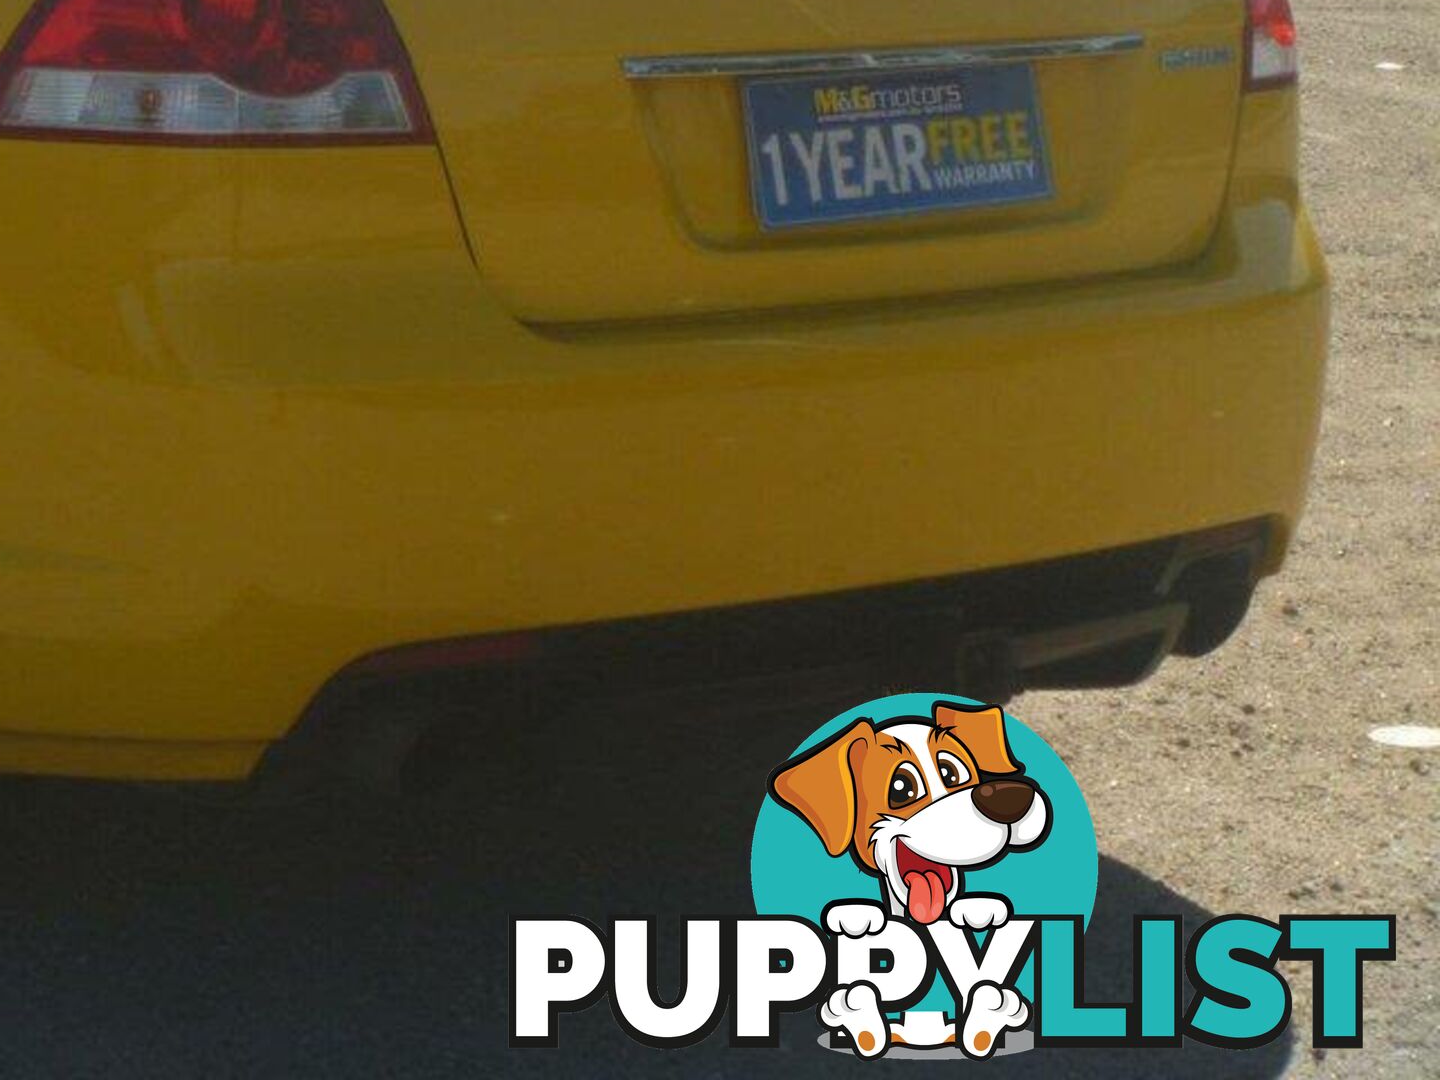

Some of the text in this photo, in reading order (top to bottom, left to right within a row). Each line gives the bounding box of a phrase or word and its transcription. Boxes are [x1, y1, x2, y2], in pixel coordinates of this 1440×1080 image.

[789, 123, 932, 203] YEAR
[927, 111, 1032, 163] FREE
[934, 158, 1036, 191] WARRANTY
